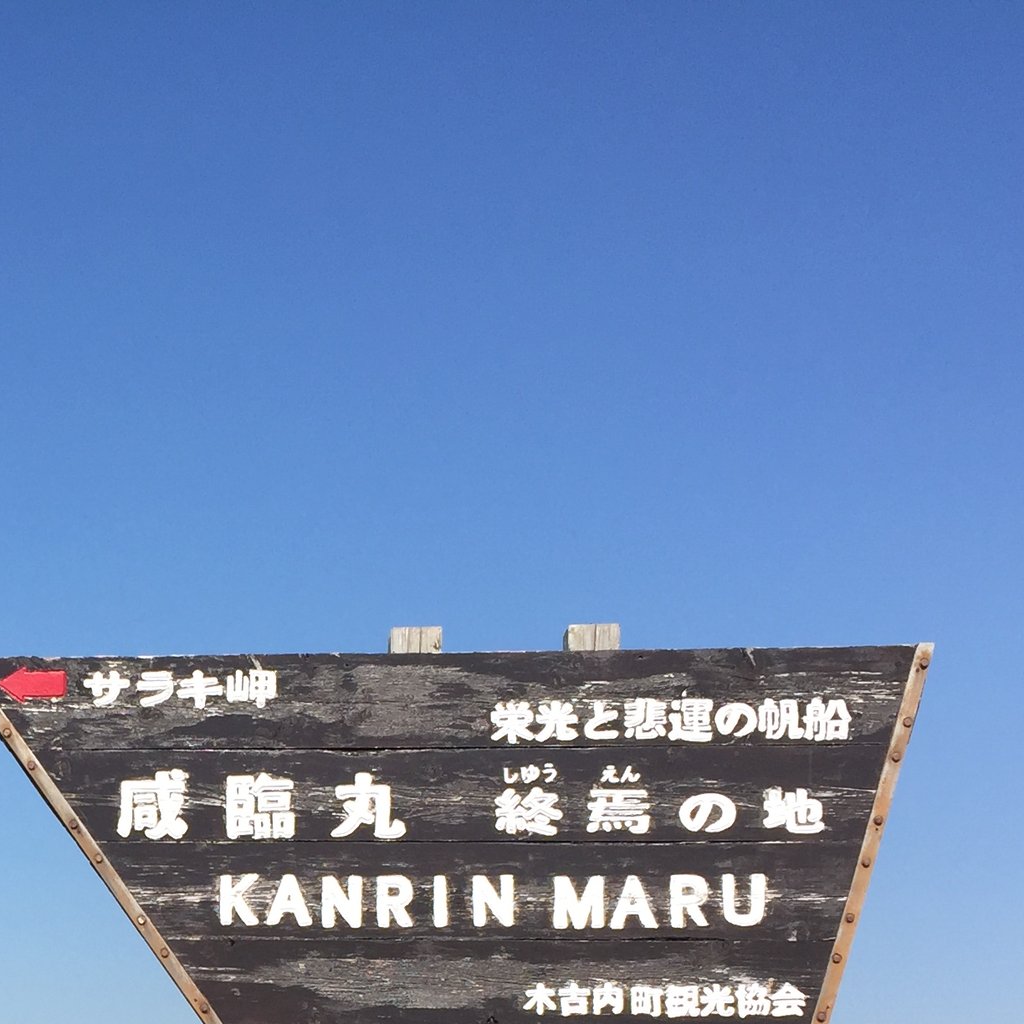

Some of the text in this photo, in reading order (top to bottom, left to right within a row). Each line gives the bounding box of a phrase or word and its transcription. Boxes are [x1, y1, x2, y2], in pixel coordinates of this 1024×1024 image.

[83, 669, 277, 710] サラキ岬
[490, 698, 852, 744] 栄光と悲運の帆船
[600, 765, 641, 783] えん
[117, 769, 825, 840] 咸臨丸 終焉の地
[217, 873, 768, 930] KANRIN MARU
[523, 982, 807, 1018] 木古内町観光協会
